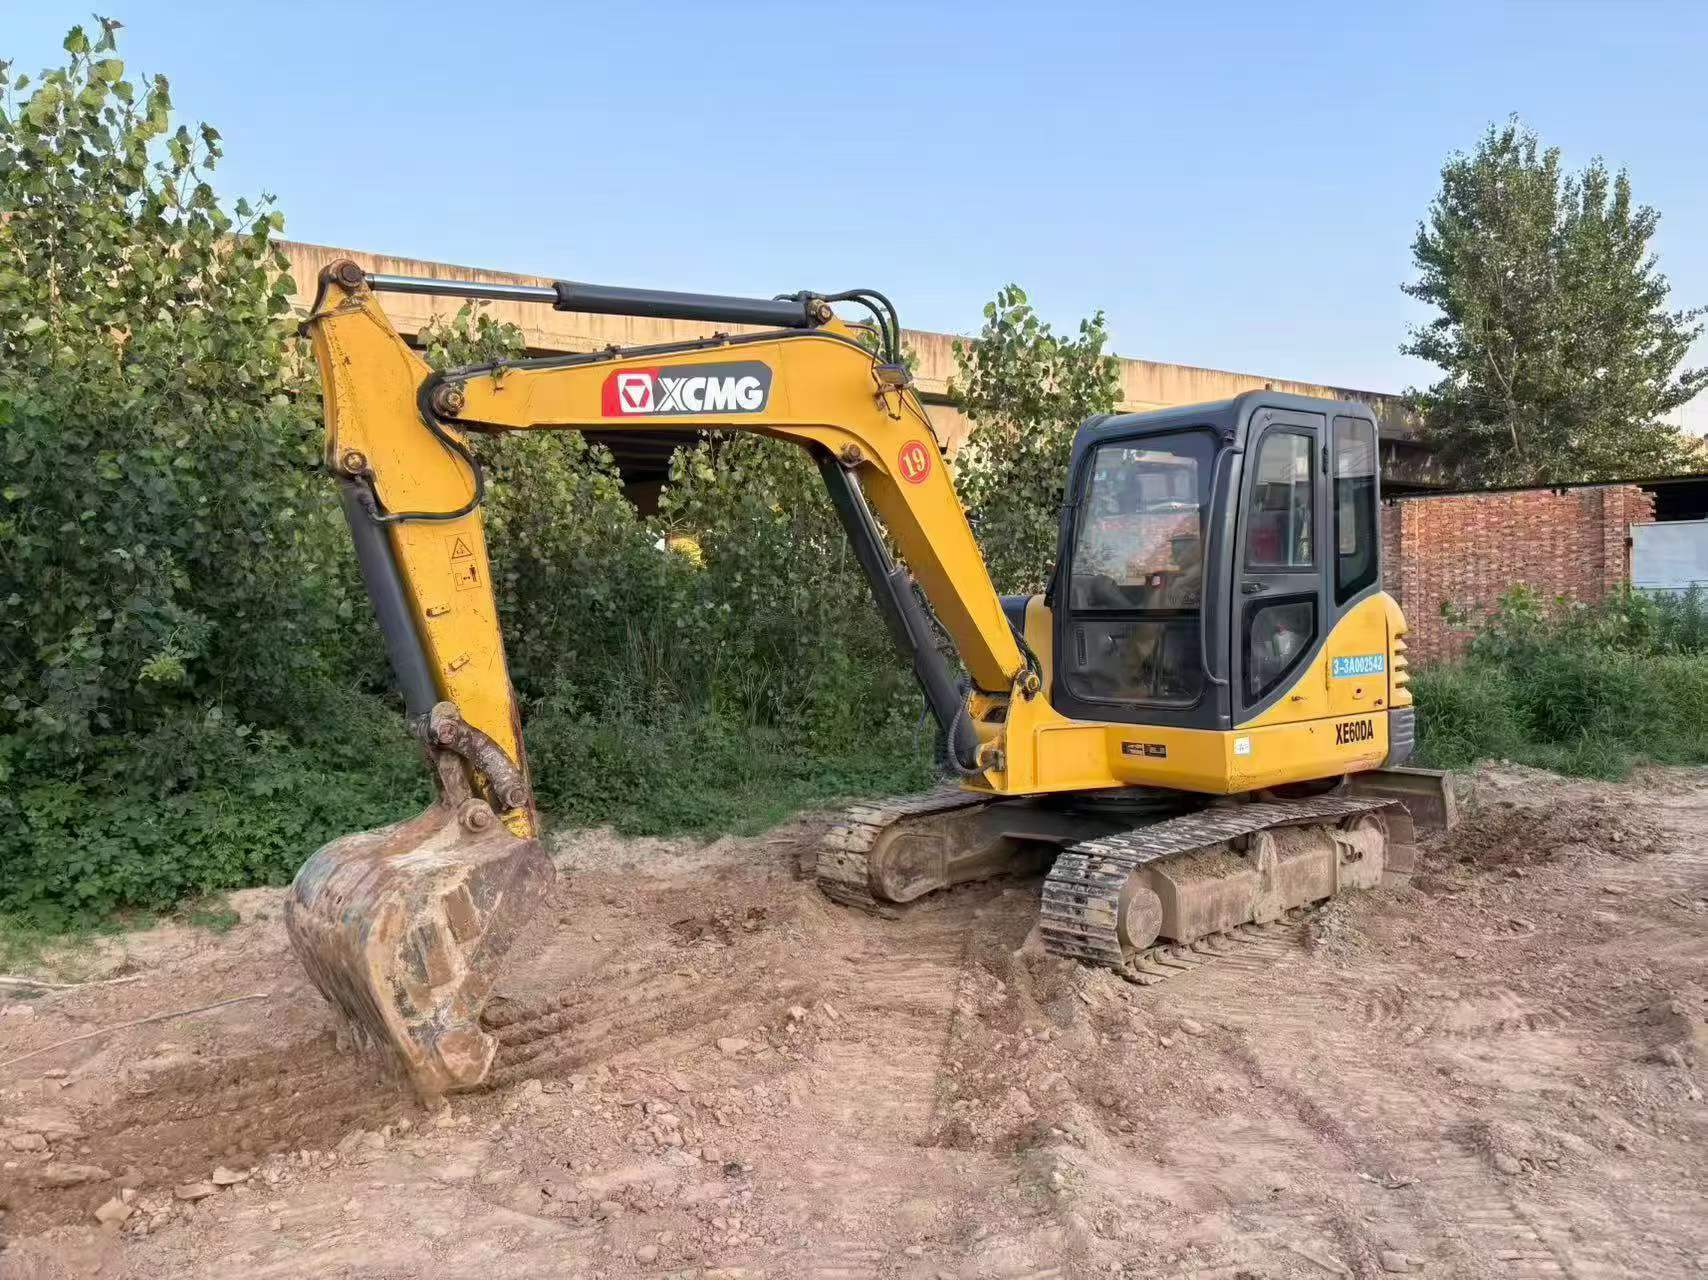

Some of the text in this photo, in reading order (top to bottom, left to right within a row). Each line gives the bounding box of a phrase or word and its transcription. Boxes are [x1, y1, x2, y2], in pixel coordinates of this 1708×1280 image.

[655, 376, 764, 412] XCMG
[902, 447, 926, 477] 19
[1335, 719, 1374, 746] XE60DA
